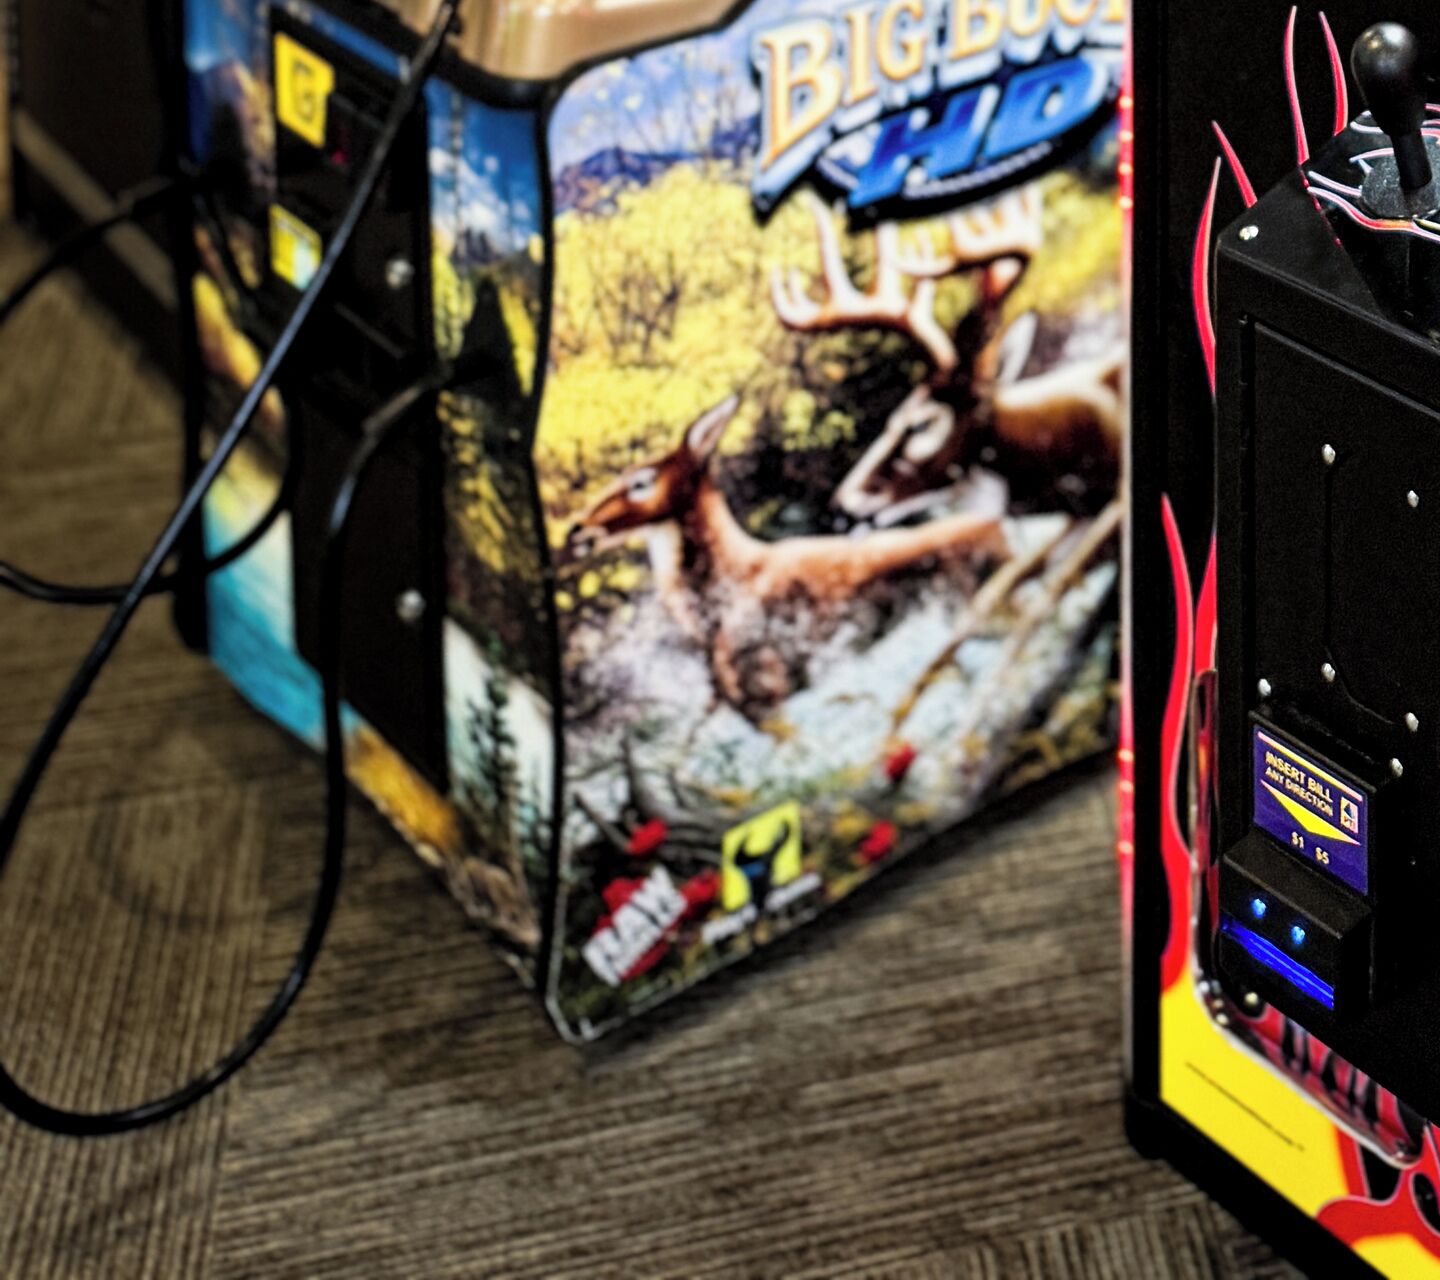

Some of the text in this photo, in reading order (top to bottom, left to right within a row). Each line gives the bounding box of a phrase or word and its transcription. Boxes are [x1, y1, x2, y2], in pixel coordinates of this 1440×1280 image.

[847, 55, 1106, 208] HD
[1265, 751, 1333, 803] INSERT BILL
[1265, 766, 1333, 817] ANY DIRECTION
